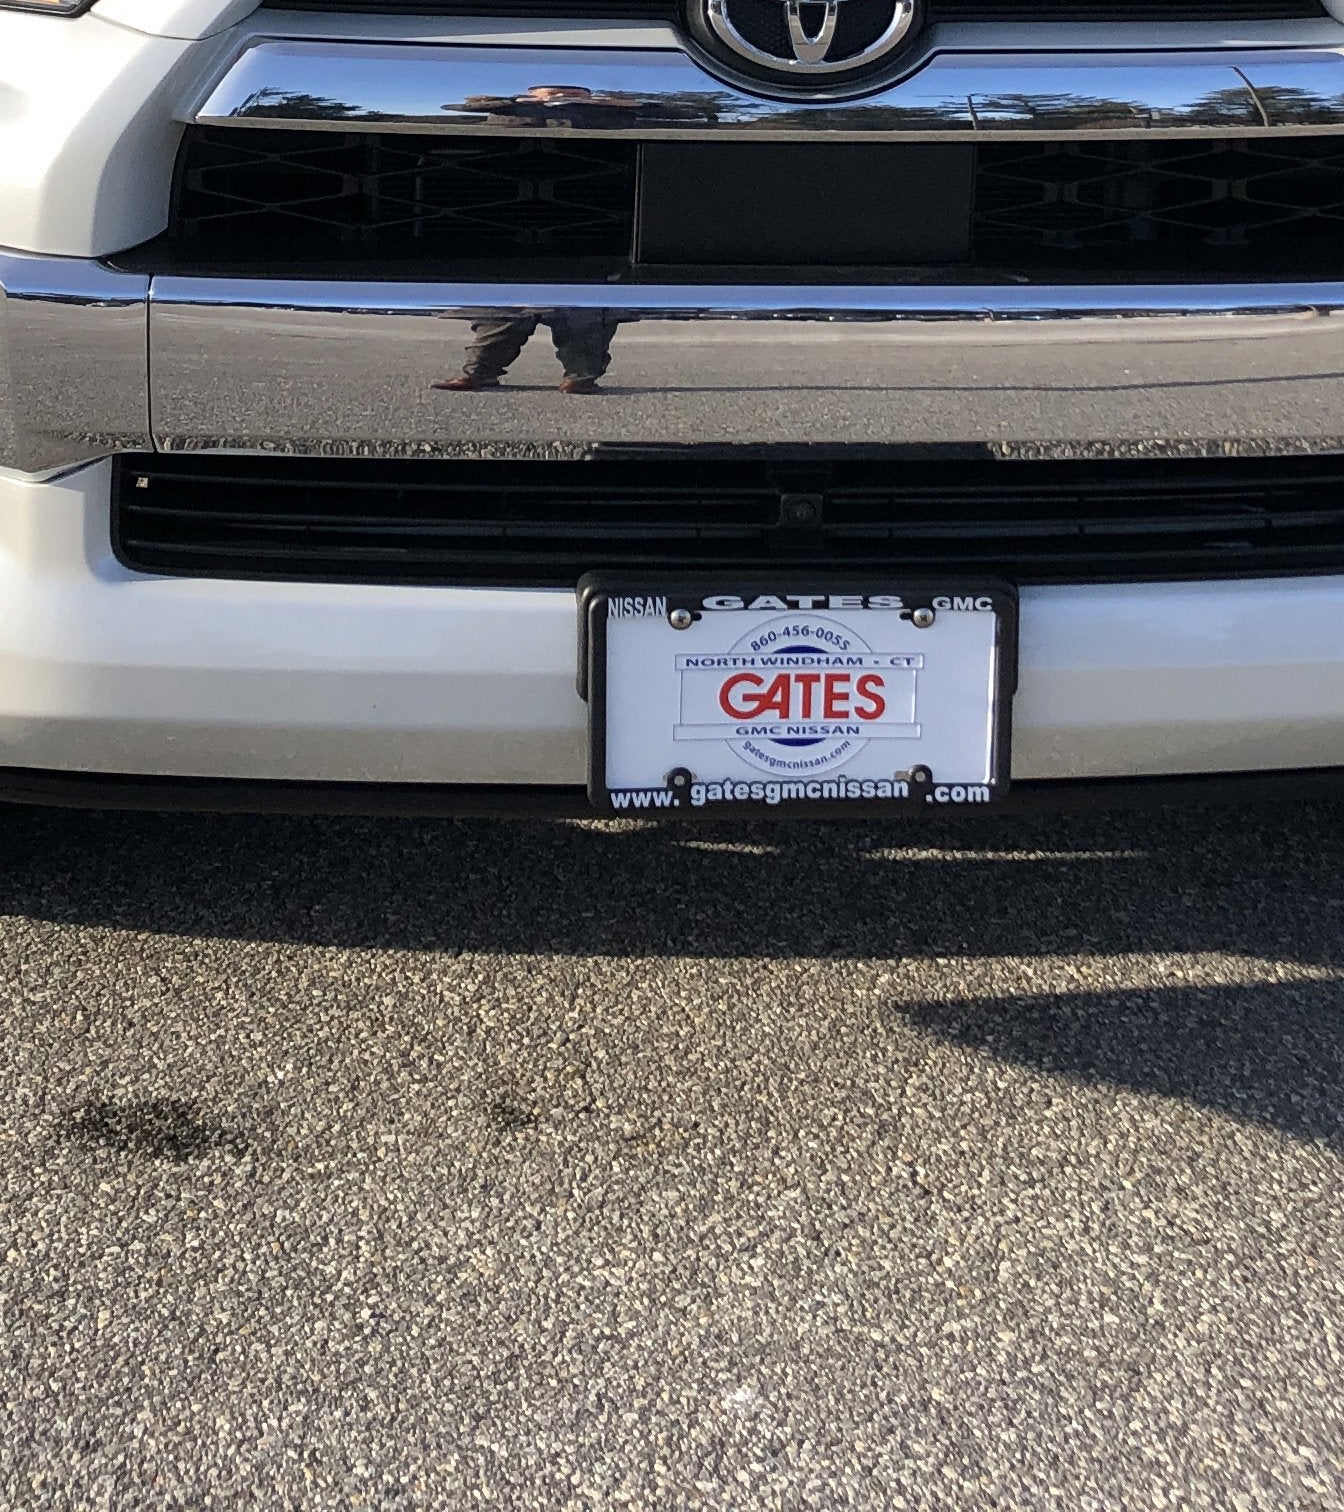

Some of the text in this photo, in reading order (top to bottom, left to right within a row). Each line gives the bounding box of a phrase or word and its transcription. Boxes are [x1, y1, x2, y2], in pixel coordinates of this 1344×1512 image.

[607, 595, 667, 618] NISSAN
[702, 594, 904, 610] GATES
[932, 596, 993, 611] GMC
[685, 656, 915, 667] NORTH WINDHAM CT
[719, 672, 886, 720] GATES
[735, 725, 860, 735] GMC NISSAN
[742, 740, 851, 770] gatesgmcnissan.com
[610, 776, 990, 808] www. gatesgmcnissan .com
